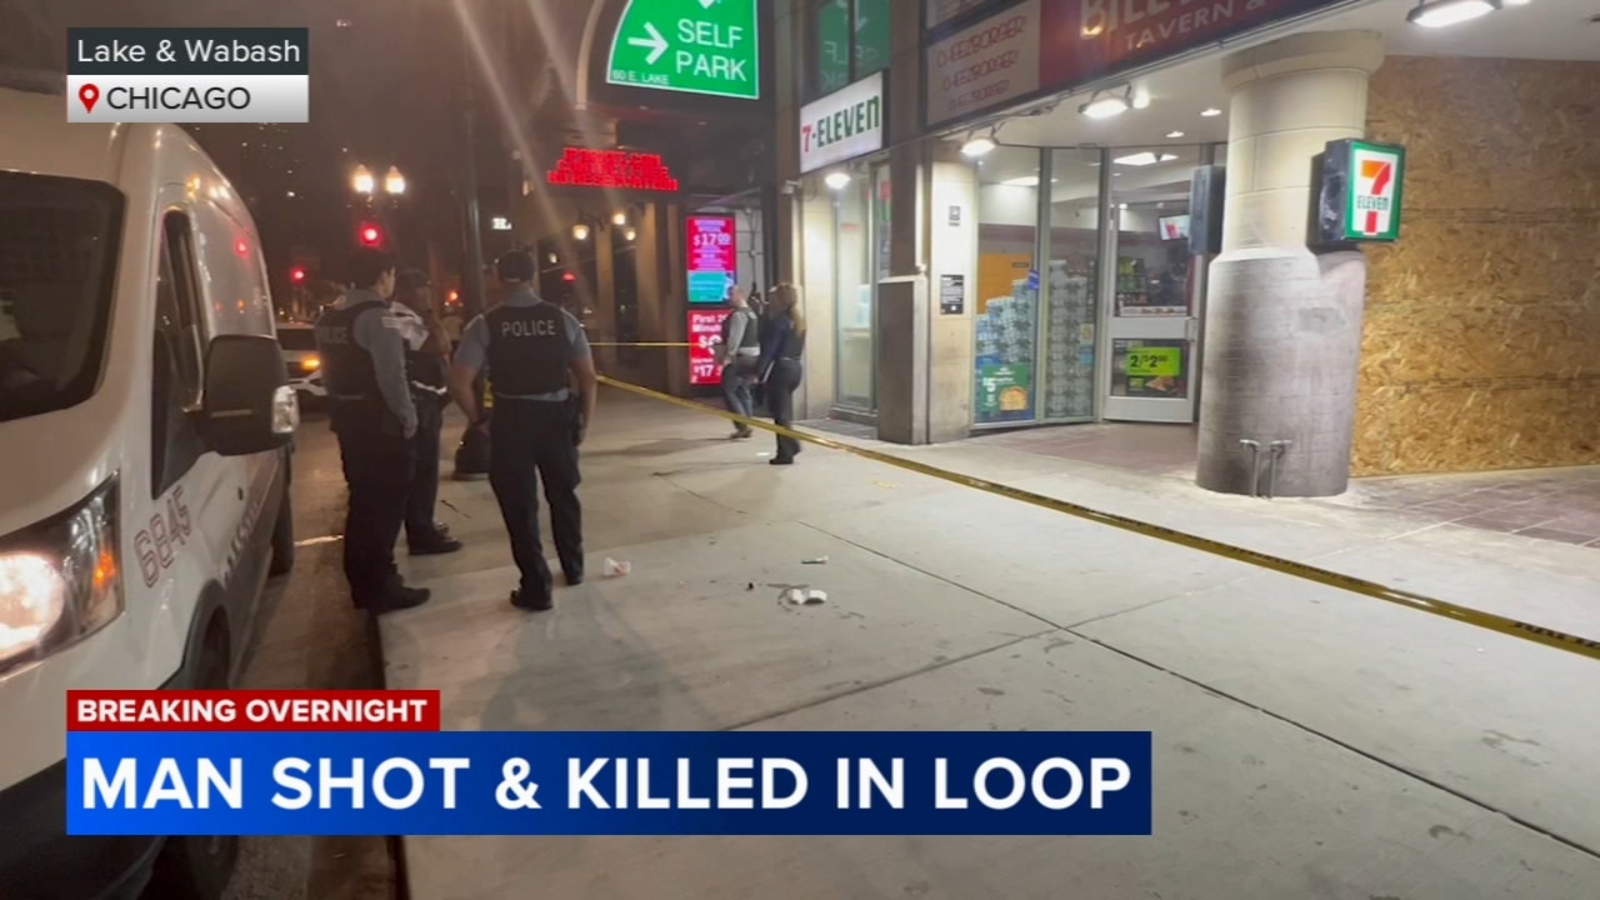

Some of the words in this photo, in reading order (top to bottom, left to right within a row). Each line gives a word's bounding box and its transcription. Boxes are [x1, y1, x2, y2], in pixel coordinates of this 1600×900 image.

[677, 18, 743, 49] SELF
[1126, 2, 1234, 50] TAVERN
[641, 73, 670, 86] LAKE
[676, 50, 747, 82] PARK
[1361, 159, 1391, 233] 7
[501, 320, 557, 337] POLICE
[134, 484, 191, 588] 6845
